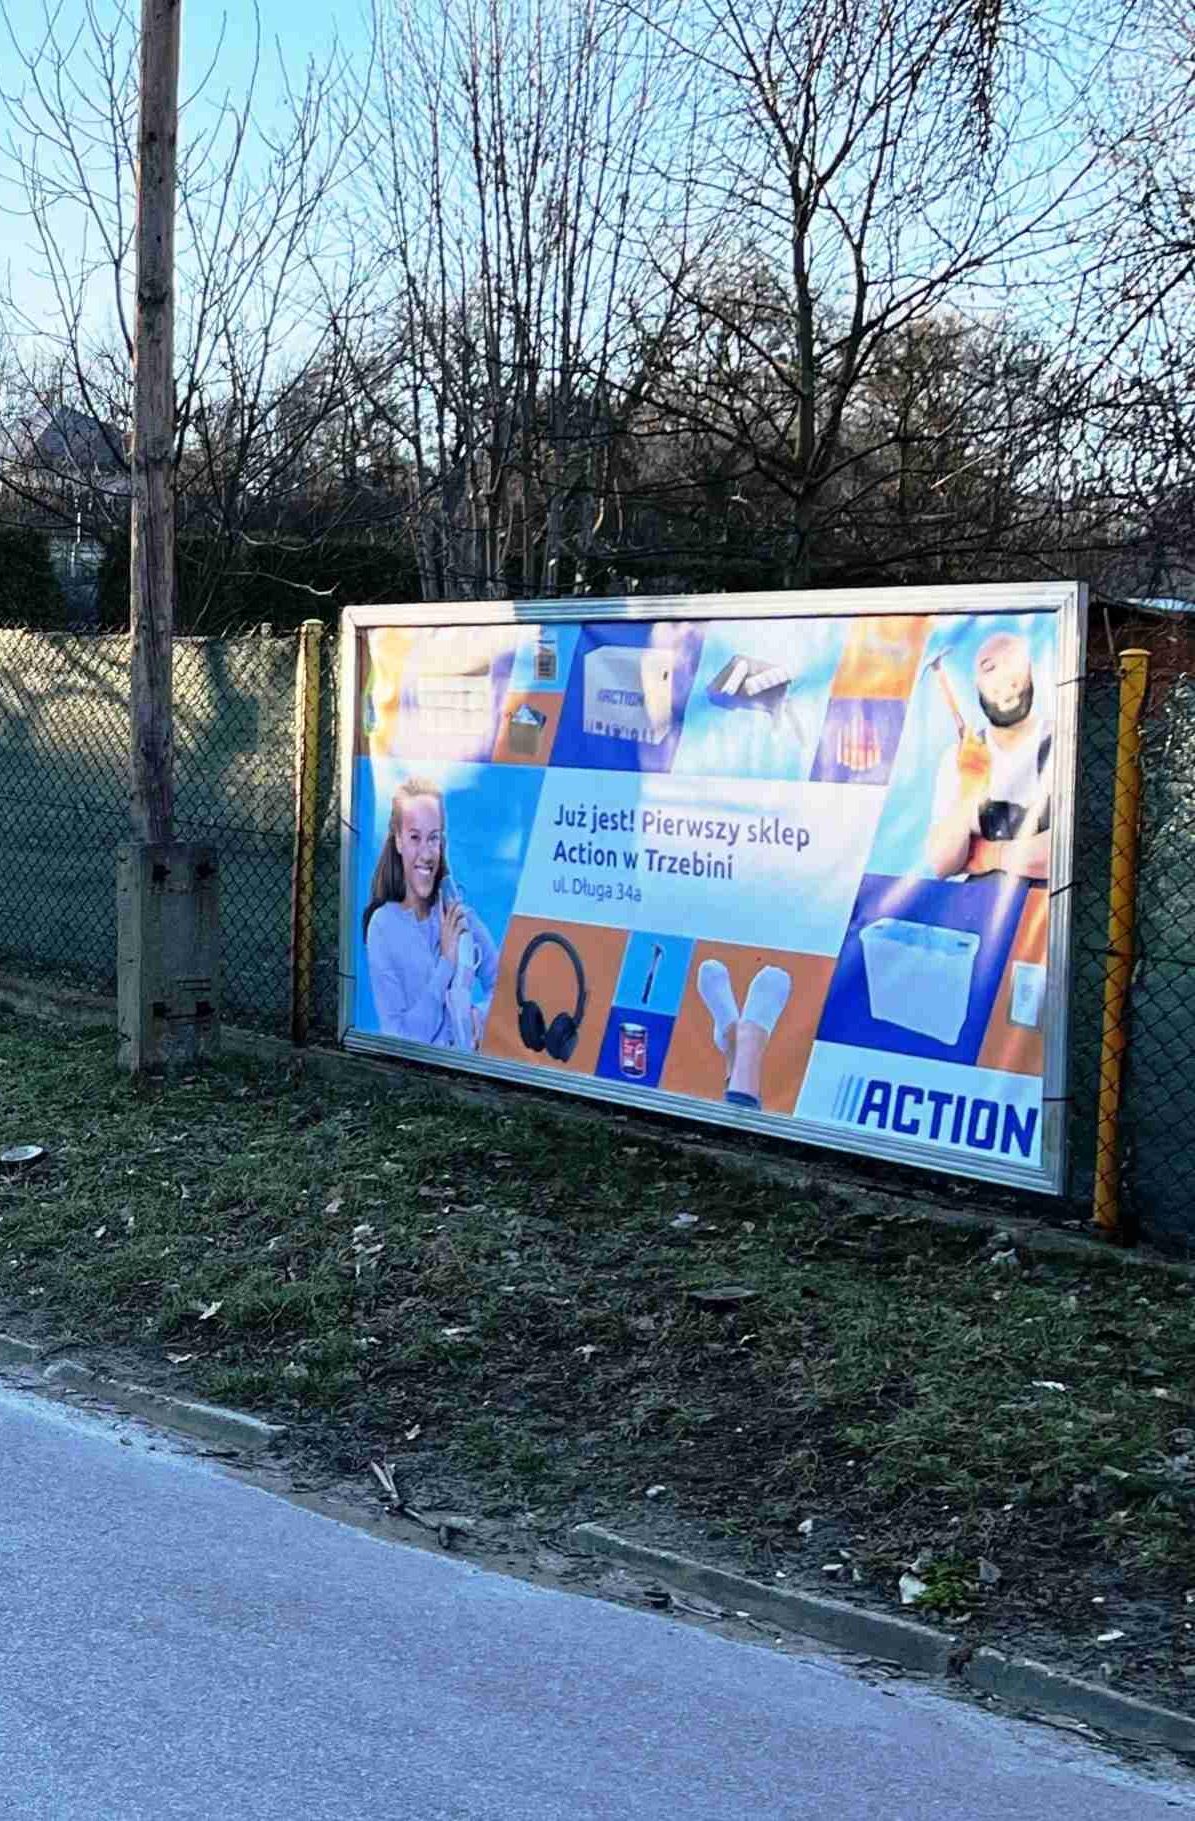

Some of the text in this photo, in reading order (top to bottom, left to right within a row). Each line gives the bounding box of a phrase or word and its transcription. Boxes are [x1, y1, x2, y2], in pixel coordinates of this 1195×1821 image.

[554, 803, 810, 852] Już jest! Pierwszy sklep
[553, 839, 733, 880] Action w Trzebini
[572, 877, 612, 902] Długa
[615, 882, 642, 902] 34a
[858, 1079, 1038, 1158] ACTION
